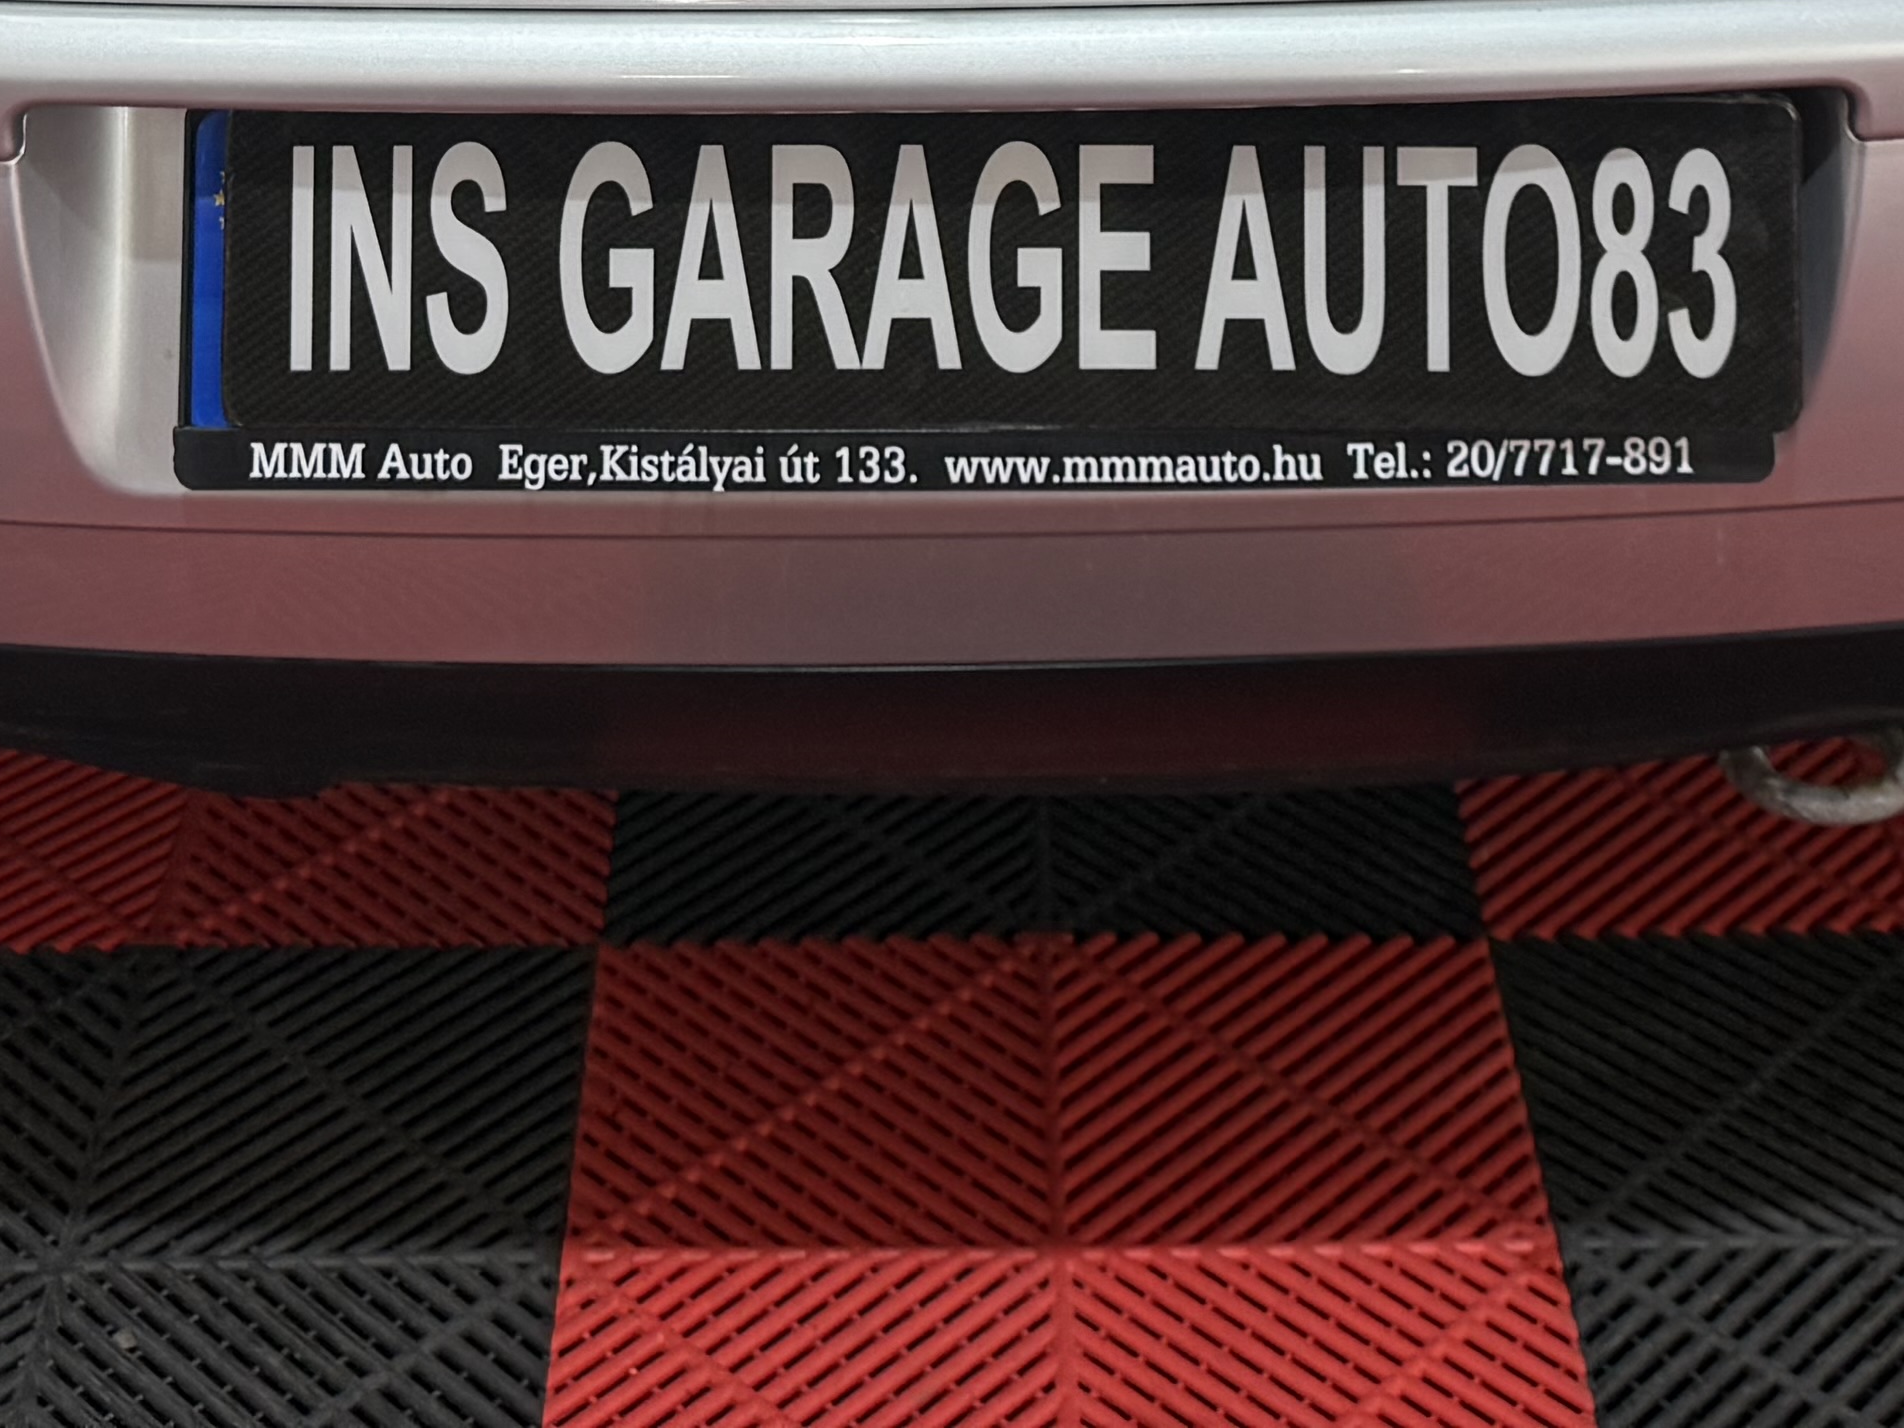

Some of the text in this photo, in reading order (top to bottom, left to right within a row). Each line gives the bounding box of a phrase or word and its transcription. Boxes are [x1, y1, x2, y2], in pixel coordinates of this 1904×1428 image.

[290, 140, 1737, 379] INS GARAGE AUTO83
[249, 442, 366, 480] MMM
[377, 442, 473, 481] Auto
[779, 446, 820, 483] út
[835, 446, 919, 484] 133.
[944, 444, 1324, 484] www.mmmauto.hu
[1347, 441, 1432, 480] Tel.:
[1446, 436, 1694, 482] 20/7717-891
